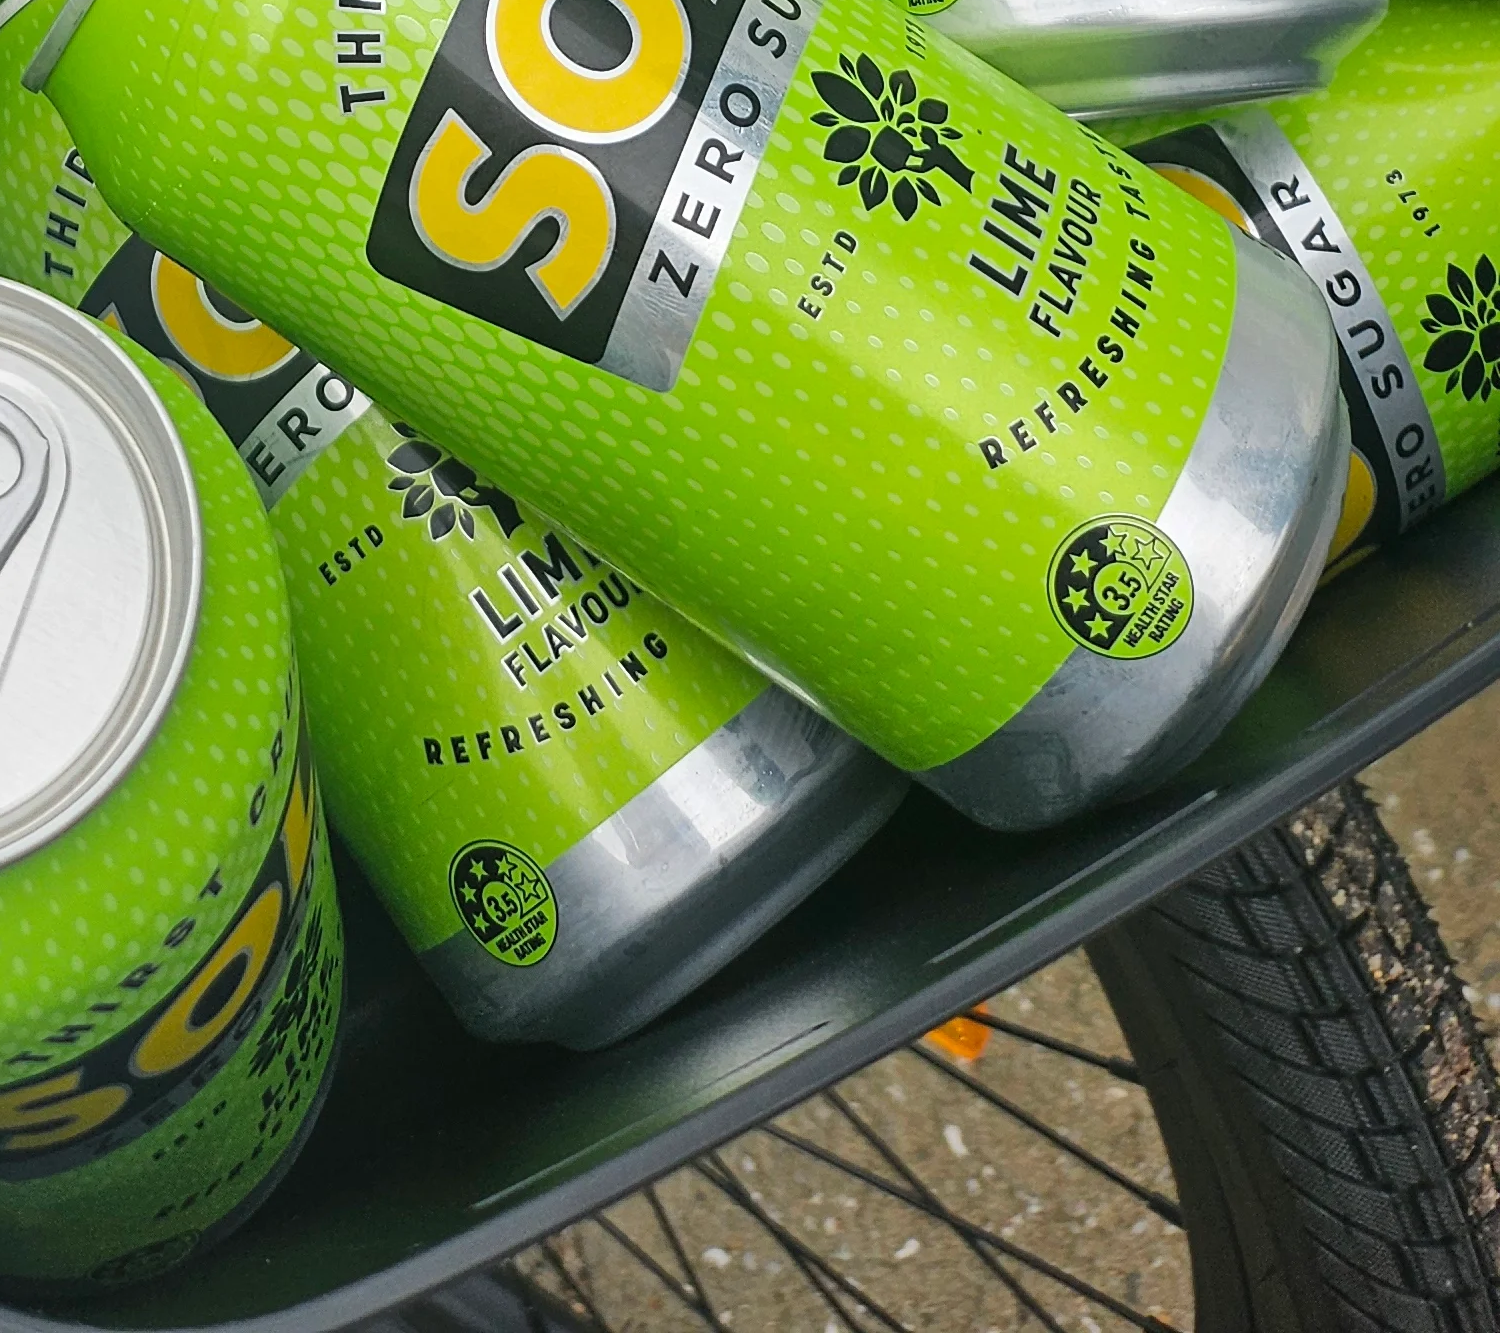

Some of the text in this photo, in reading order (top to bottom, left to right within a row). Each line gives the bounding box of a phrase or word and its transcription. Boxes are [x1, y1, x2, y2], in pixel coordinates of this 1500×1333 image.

[43, 147, 95, 280] THIR
[646, 82, 764, 299] ZERO
[968, 141, 1059, 300] LIME
[1384, 167, 1442, 238] 1973
[799, 229, 856, 319] ESTD
[1028, 179, 1102, 338] FLAVOUR
[977, 238, 1156, 471] REFRESHING
[1273, 175, 1438, 518] ERO SUGAR
[245, 362, 356, 490] ERO
[318, 523, 386, 588] ESTD
[1101, 570, 1143, 611] 3.5
[1122, 571, 1180, 648] HEALTH STAR
[501, 572, 643, 690] FLAVOU
[1147, 596, 1185, 644] RATING
[424, 631, 670, 767] REFRESHING
[486, 890, 519, 923] 3.5
[522, 910, 549, 934] STAR
[8, 869, 222, 1069] THIRST
